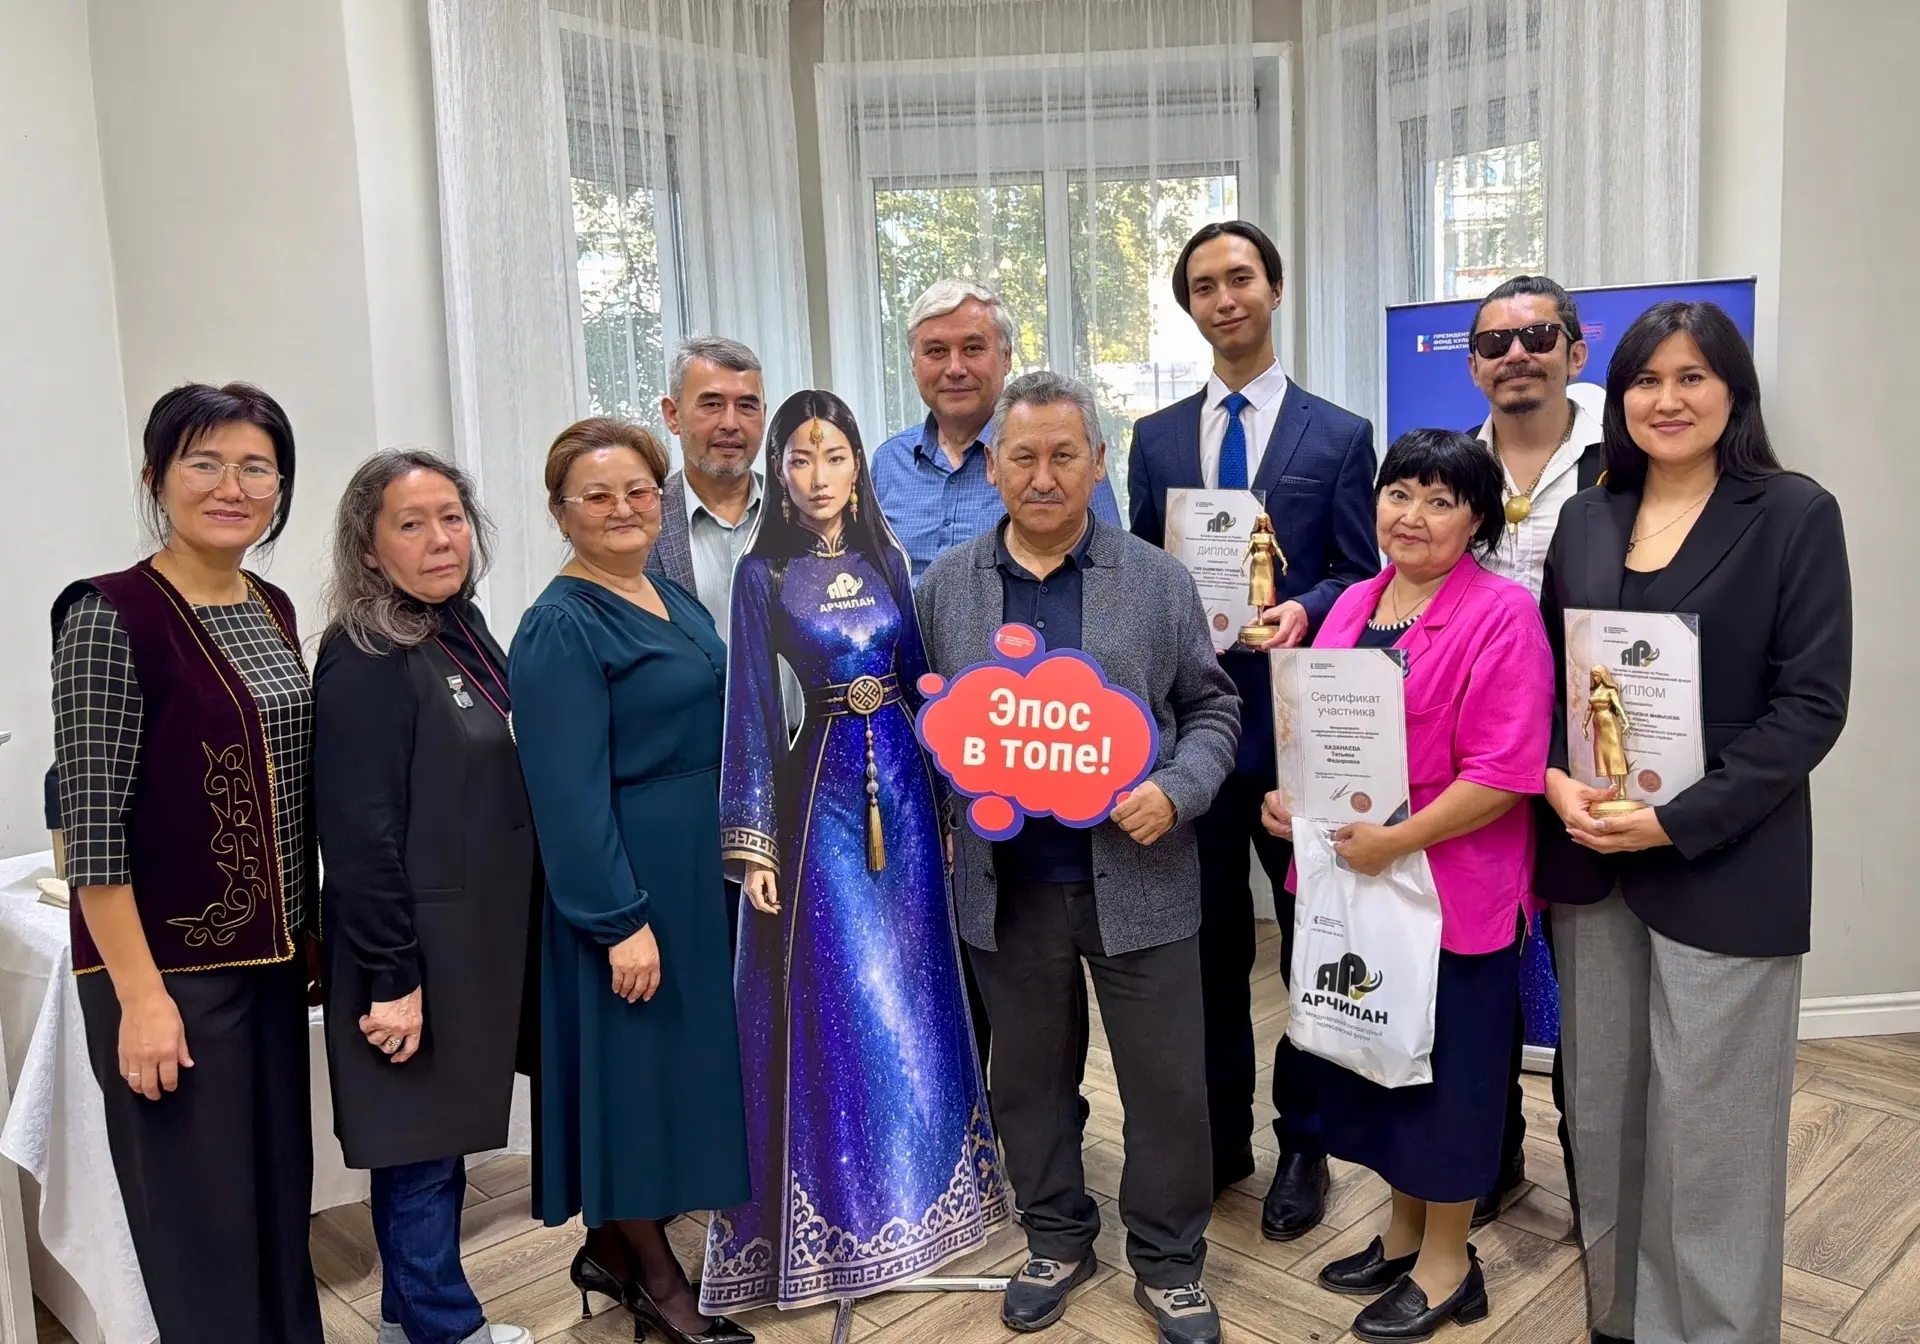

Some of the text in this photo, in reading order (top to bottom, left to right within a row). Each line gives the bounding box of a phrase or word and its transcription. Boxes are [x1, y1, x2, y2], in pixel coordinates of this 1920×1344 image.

[1433, 331, 1470, 340] ПРЕЗИДЕНТ
[1197, 545, 1238, 557] ДИПЛОМ
[820, 596, 876, 613] АРЧИЛАН
[1311, 691, 1381, 705] Сертификат
[1620, 684, 1666, 699] ИПЛОМ
[988, 687, 1092, 732] Эпос
[1317, 706, 1376, 719] участника
[1324, 744, 1361, 752] КАЗАНАЕВА
[962, 736, 1112, 775] в топе!
[1326, 757, 1360, 765] Федоровна
[1301, 992, 1388, 1025] АРЧИЛАН
